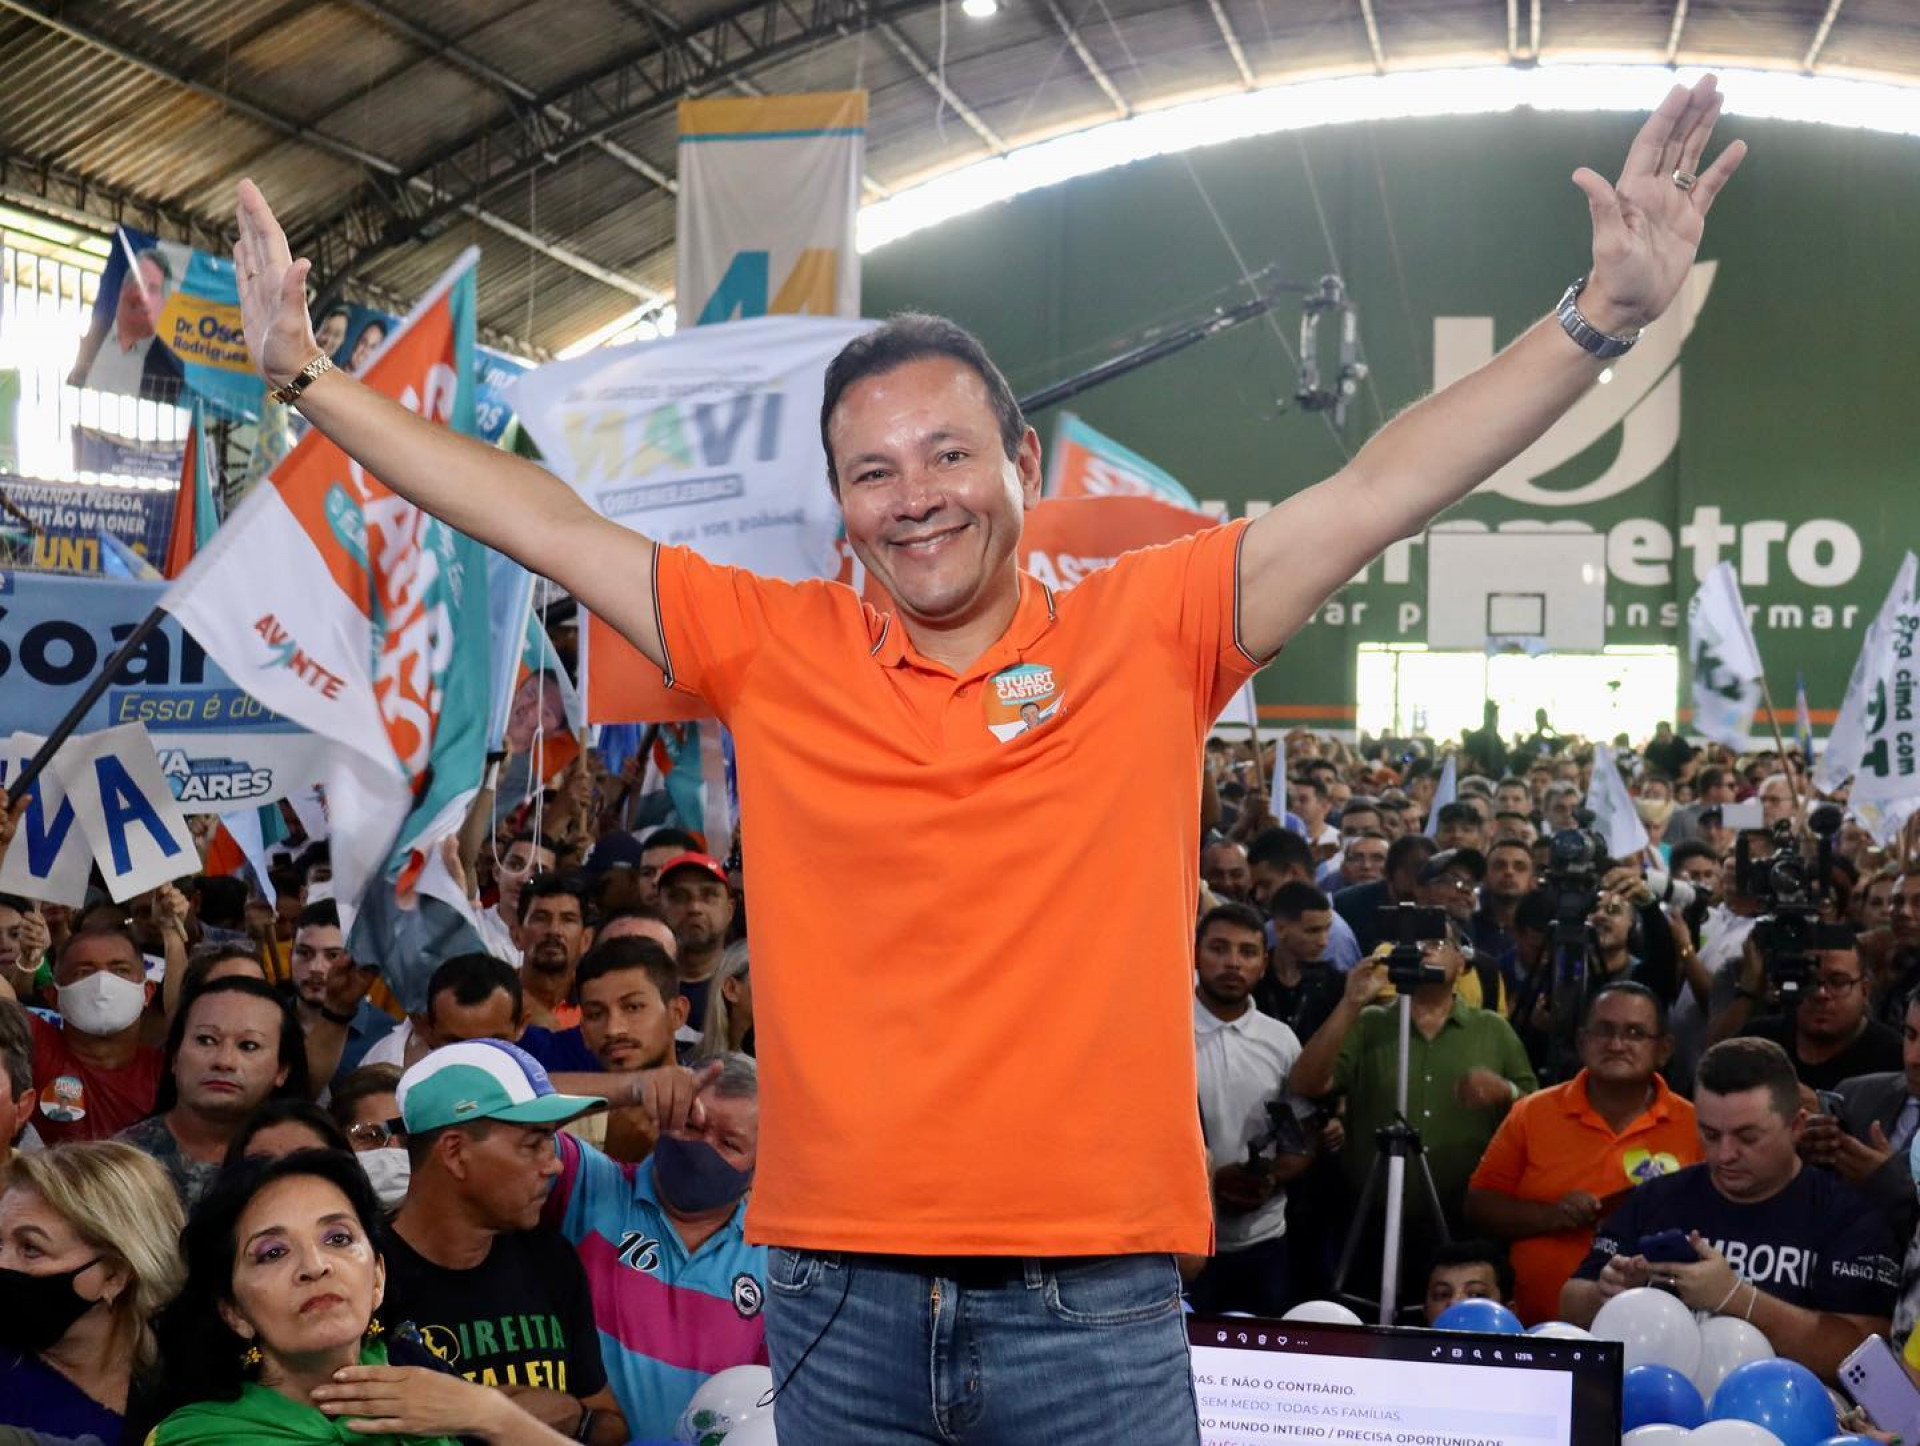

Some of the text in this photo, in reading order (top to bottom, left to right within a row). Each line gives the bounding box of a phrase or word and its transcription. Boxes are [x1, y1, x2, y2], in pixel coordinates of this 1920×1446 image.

[175, 316, 246, 346] Dr. Osc
[81, 513, 146, 534] WAGNER
[0, 604, 206, 686] oar
[253, 613, 347, 700] AVANTE
[996, 671, 1052, 690] STUART
[997, 682, 1055, 699] CASTRO
[119, 694, 194, 722] Essa
[203, 693, 219, 720] é
[1895, 670, 1918, 721] cima
[1896, 732, 1915, 776] com
[618, 1230, 660, 1271] 16
[1232, 1376, 1260, 1388] NÃO
[1264, 1379, 1273, 1390] O
[1277, 1380, 1356, 1396] CONTRÁRIO.
[1201, 1396, 1227, 1408] SEM
[1277, 1402, 1318, 1416] TODAS
[1322, 1406, 1338, 1416] AS
[1220, 1420, 1270, 1433] MUNDO
[1273, 1424, 1325, 1438] INTEIRO
[1337, 1429, 1393, 1443] PRECISA
[1397, 1433, 1504, 1446] OPORTUNIDADE
